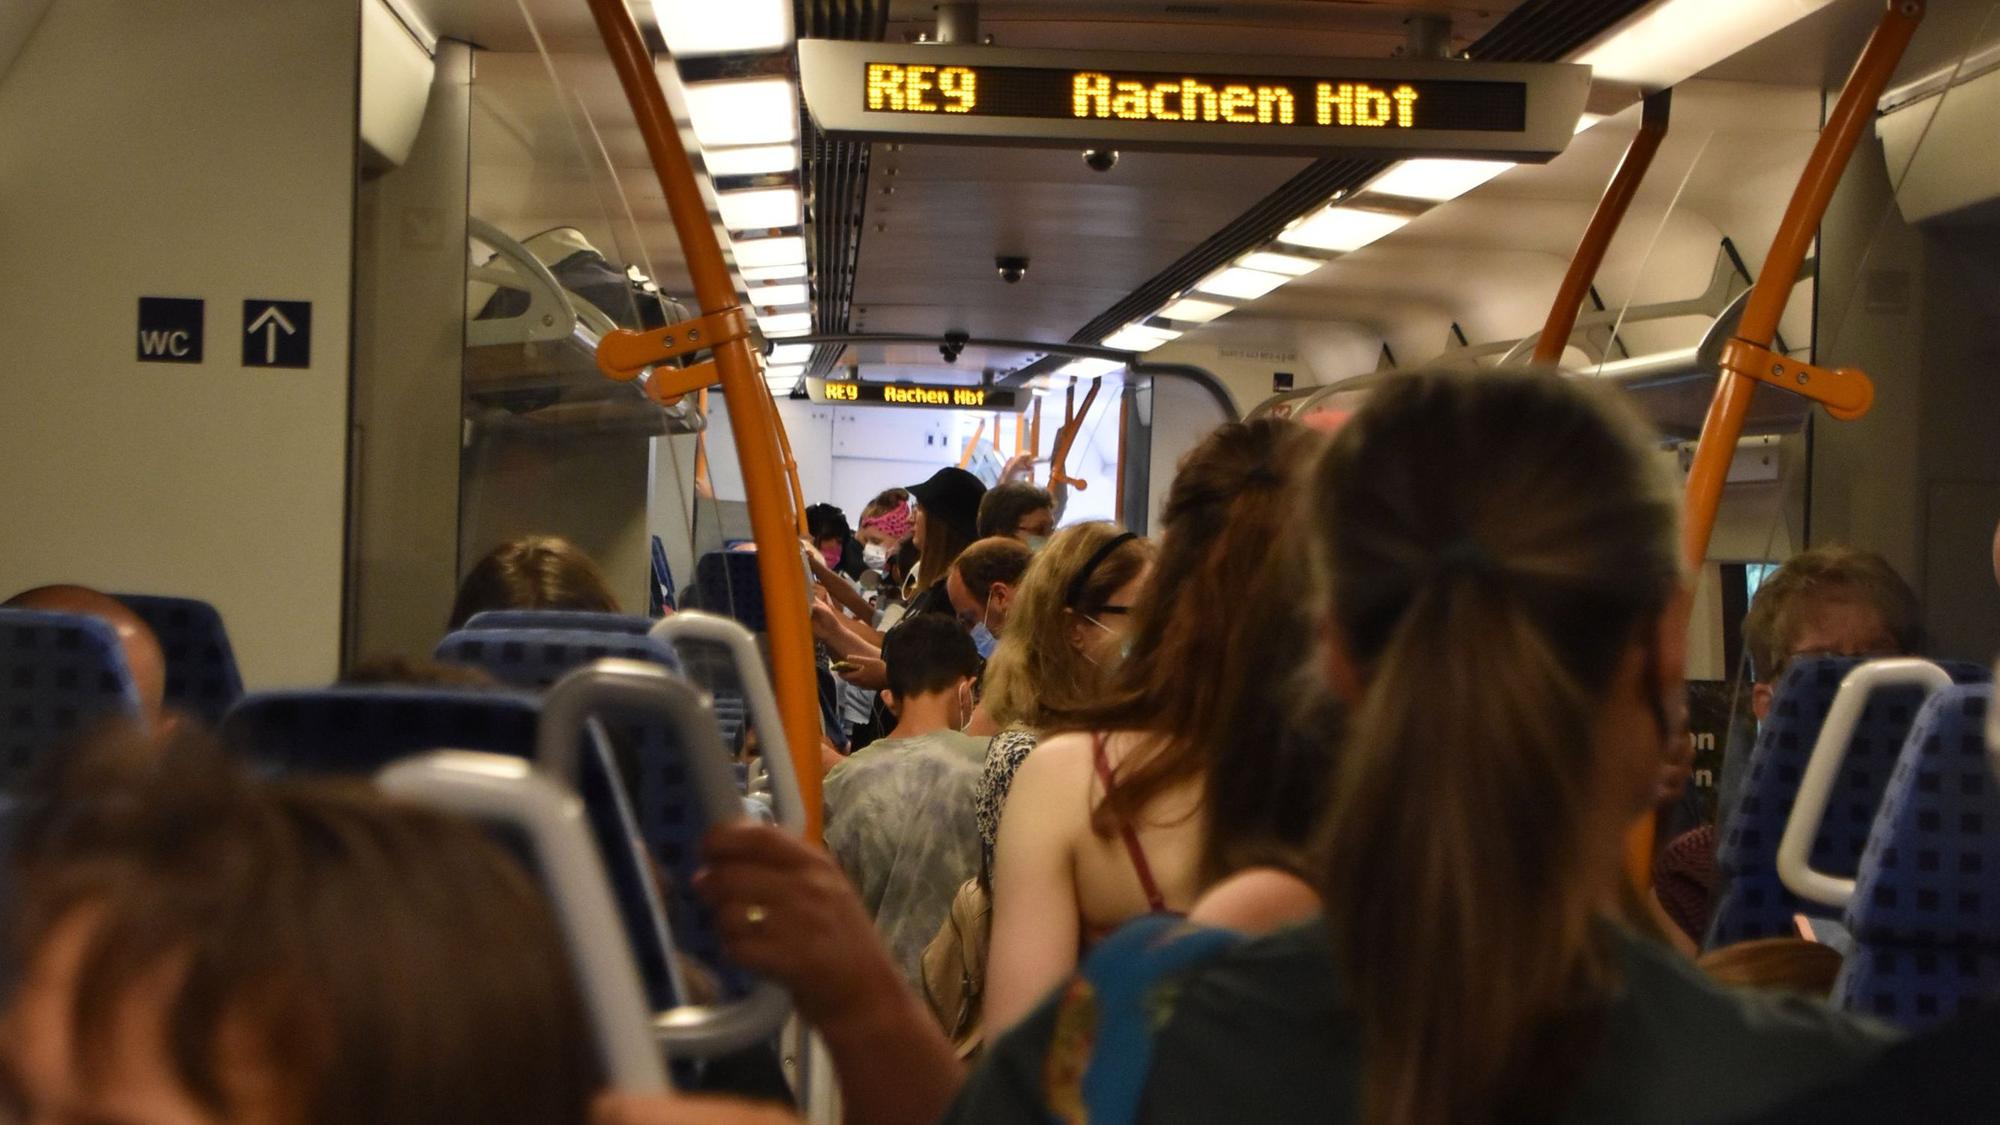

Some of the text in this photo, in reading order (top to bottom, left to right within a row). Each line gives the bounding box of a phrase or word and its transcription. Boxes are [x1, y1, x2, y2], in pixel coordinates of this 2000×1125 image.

[866, 63, 1418, 128] RE9 Aachen Hbf
[140, 330, 190, 357] WC
[824, 382, 985, 406] RE9 Aachen Hbf
